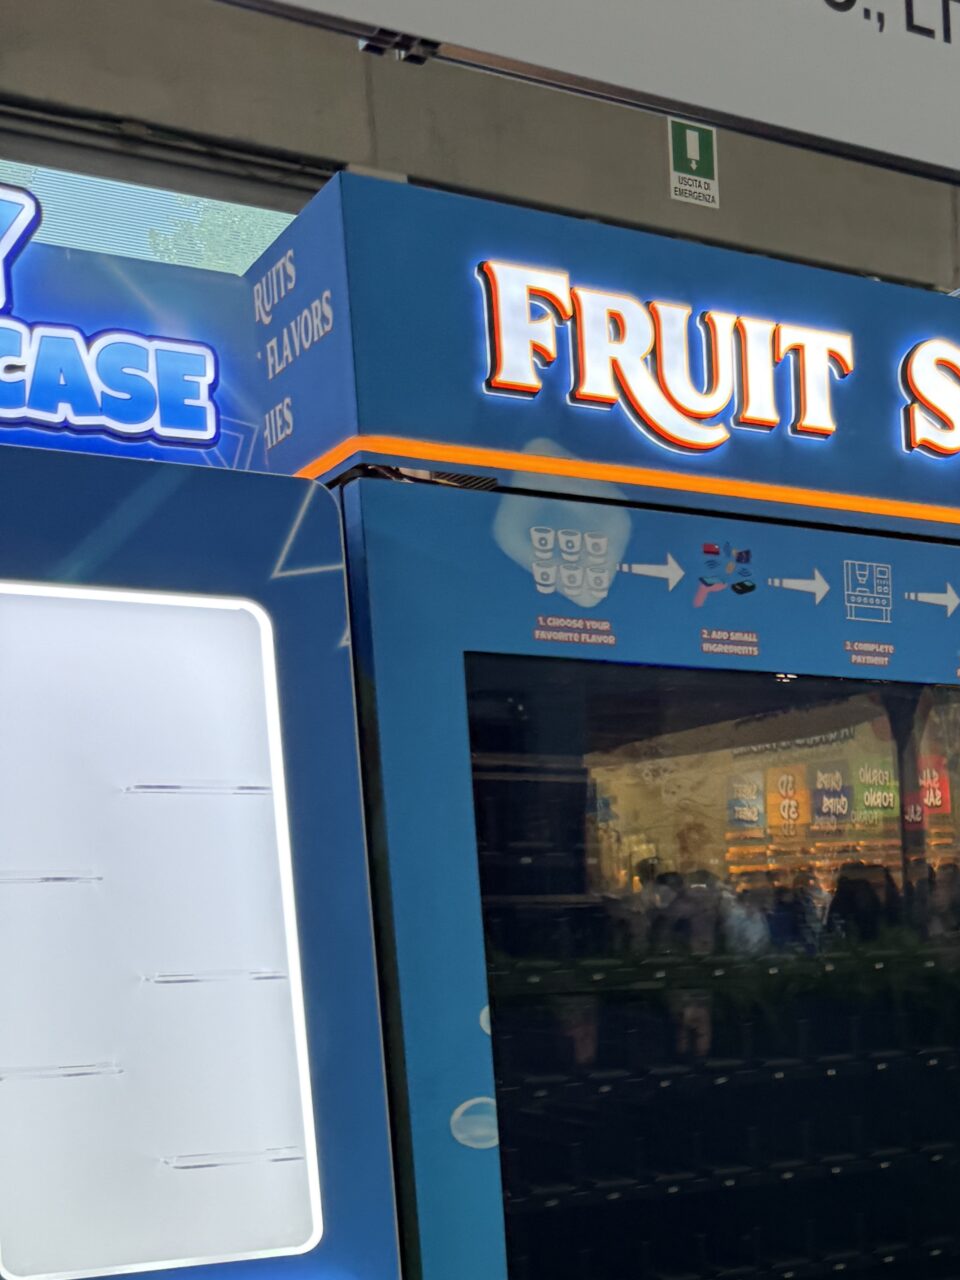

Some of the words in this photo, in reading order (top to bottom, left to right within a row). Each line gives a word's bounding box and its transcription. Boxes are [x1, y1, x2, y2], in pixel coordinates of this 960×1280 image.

[674, 186, 716, 203] EMERGENZA
[678, 175, 702, 189] USCITA
[703, 181, 711, 191] DI
[266, 289, 334, 381] FLAVORS
[477, 259, 854, 455] FRUIT
